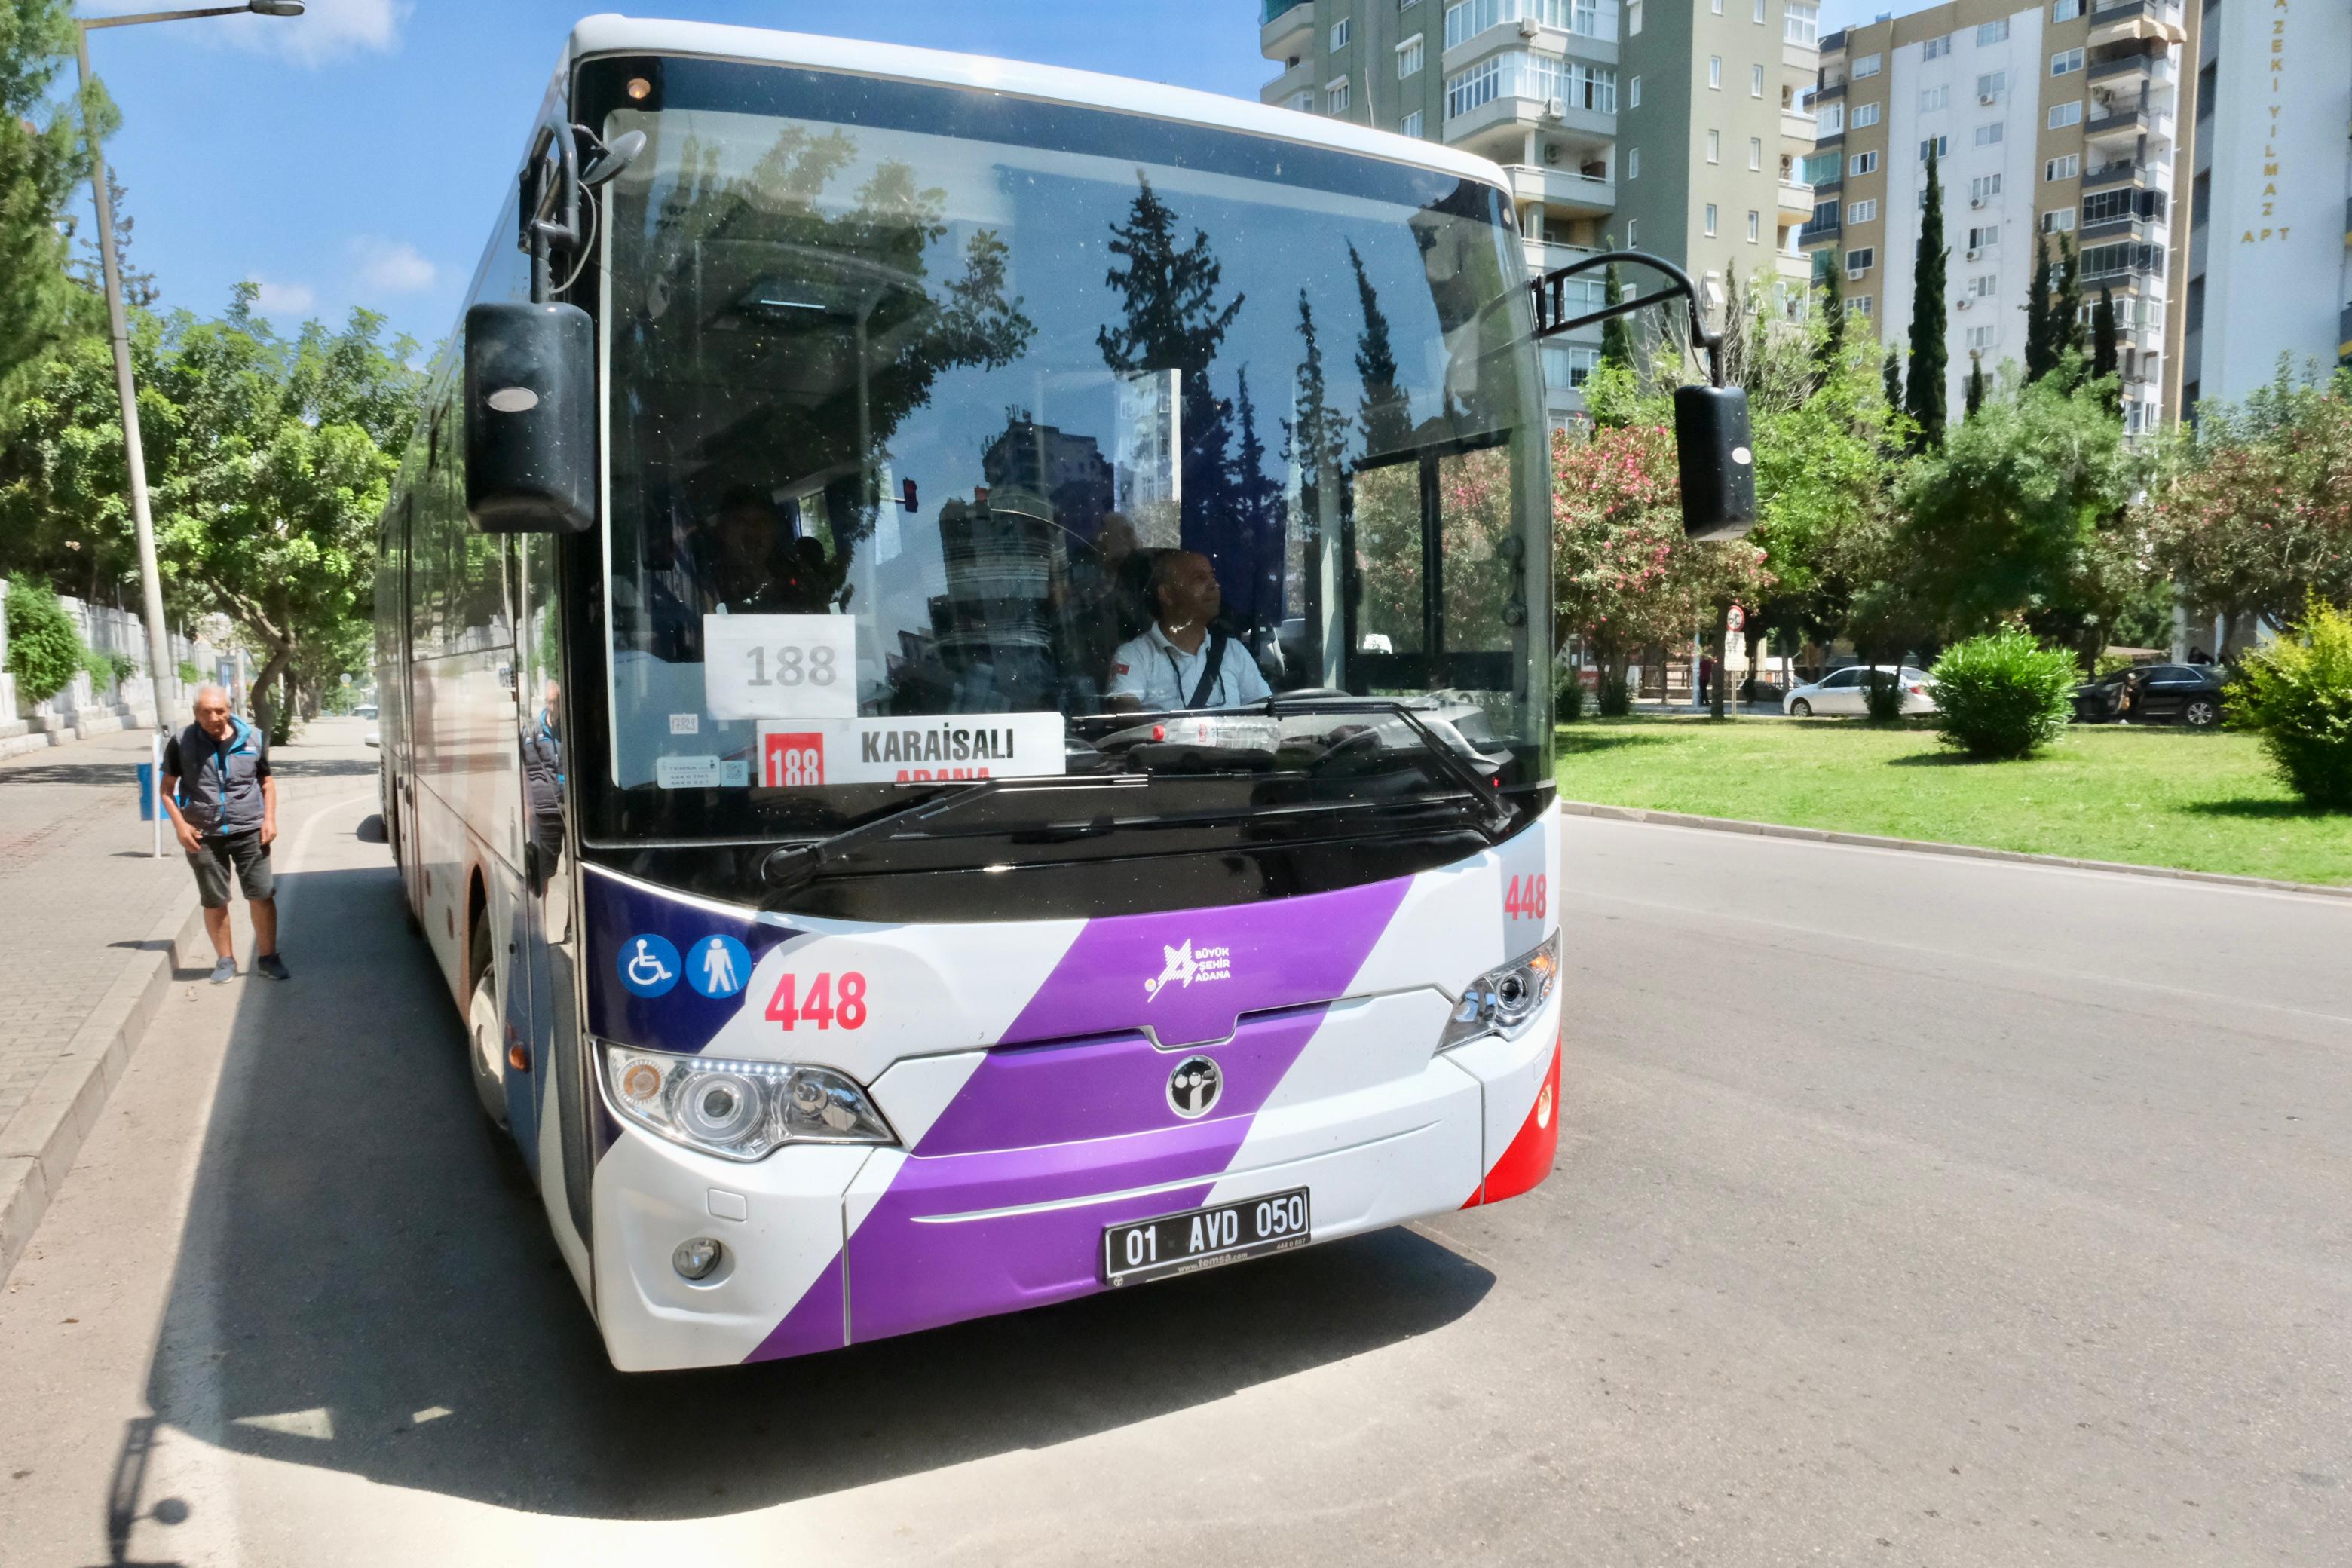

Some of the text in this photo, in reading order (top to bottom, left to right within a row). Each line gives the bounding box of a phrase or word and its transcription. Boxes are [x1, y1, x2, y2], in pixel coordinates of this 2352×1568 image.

[2262, 105, 2280, 216] YILMAZ
[2240, 227, 2290, 244] APT
[746, 645, 837, 687] 188
[771, 722, 1014, 787] 188 KARAİSALI
[1504, 874, 1547, 920] 448
[1195, 946, 1230, 960] BÜYÜK
[1199, 957, 1230, 973] ŞEHİR
[1195, 969, 1231, 982] ADANA
[764, 971, 868, 1031] 448
[1126, 1195, 1303, 1266] 01 AVD 050
[1178, 1252, 1248, 1273] www.temsa.com
